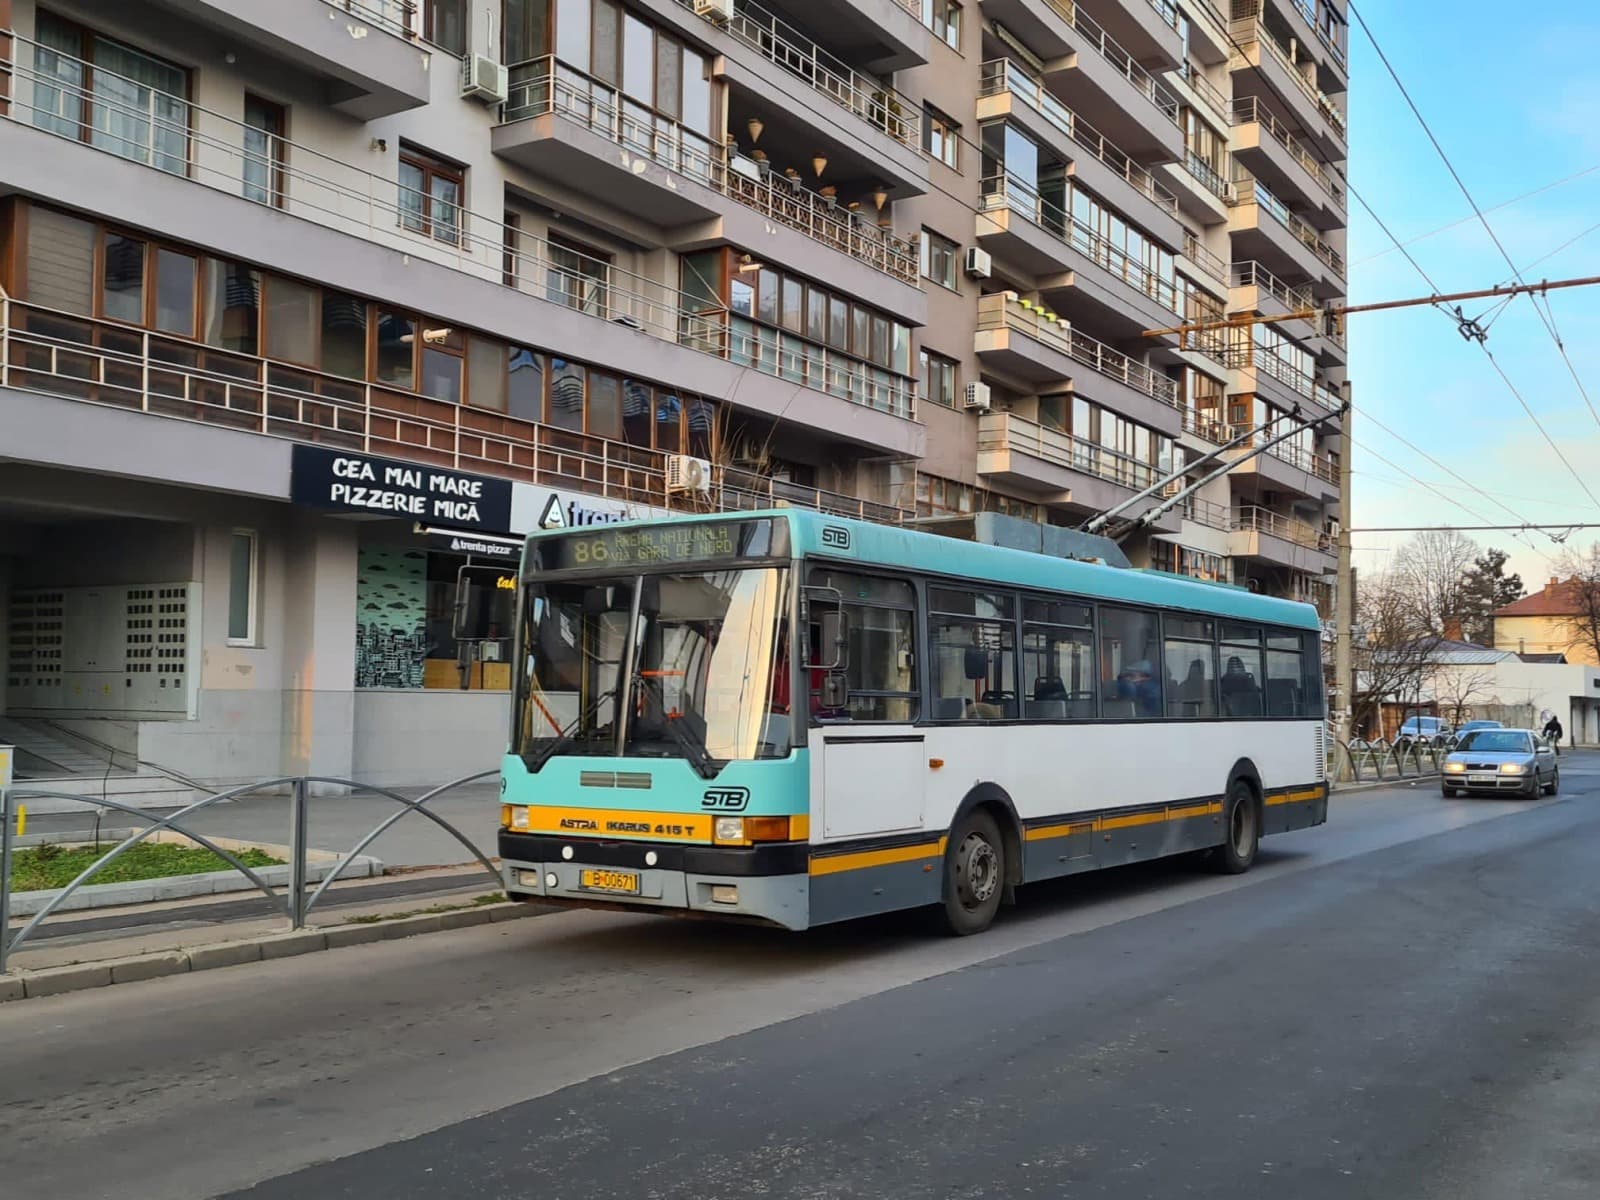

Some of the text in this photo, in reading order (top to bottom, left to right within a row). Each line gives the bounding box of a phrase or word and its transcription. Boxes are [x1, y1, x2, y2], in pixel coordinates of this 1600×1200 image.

[332, 457, 483, 498] CEA MAI MARE
[330, 483, 480, 522] PIZZERIE MICĂ
[822, 528, 847, 545] STB
[574, 540, 608, 563] 86
[676, 543, 692, 557] DE
[701, 790, 745, 806] STB
[560, 818, 598, 831] ASTRA
[606, 820, 650, 833] IKARUS
[654, 824, 682, 835] 415
